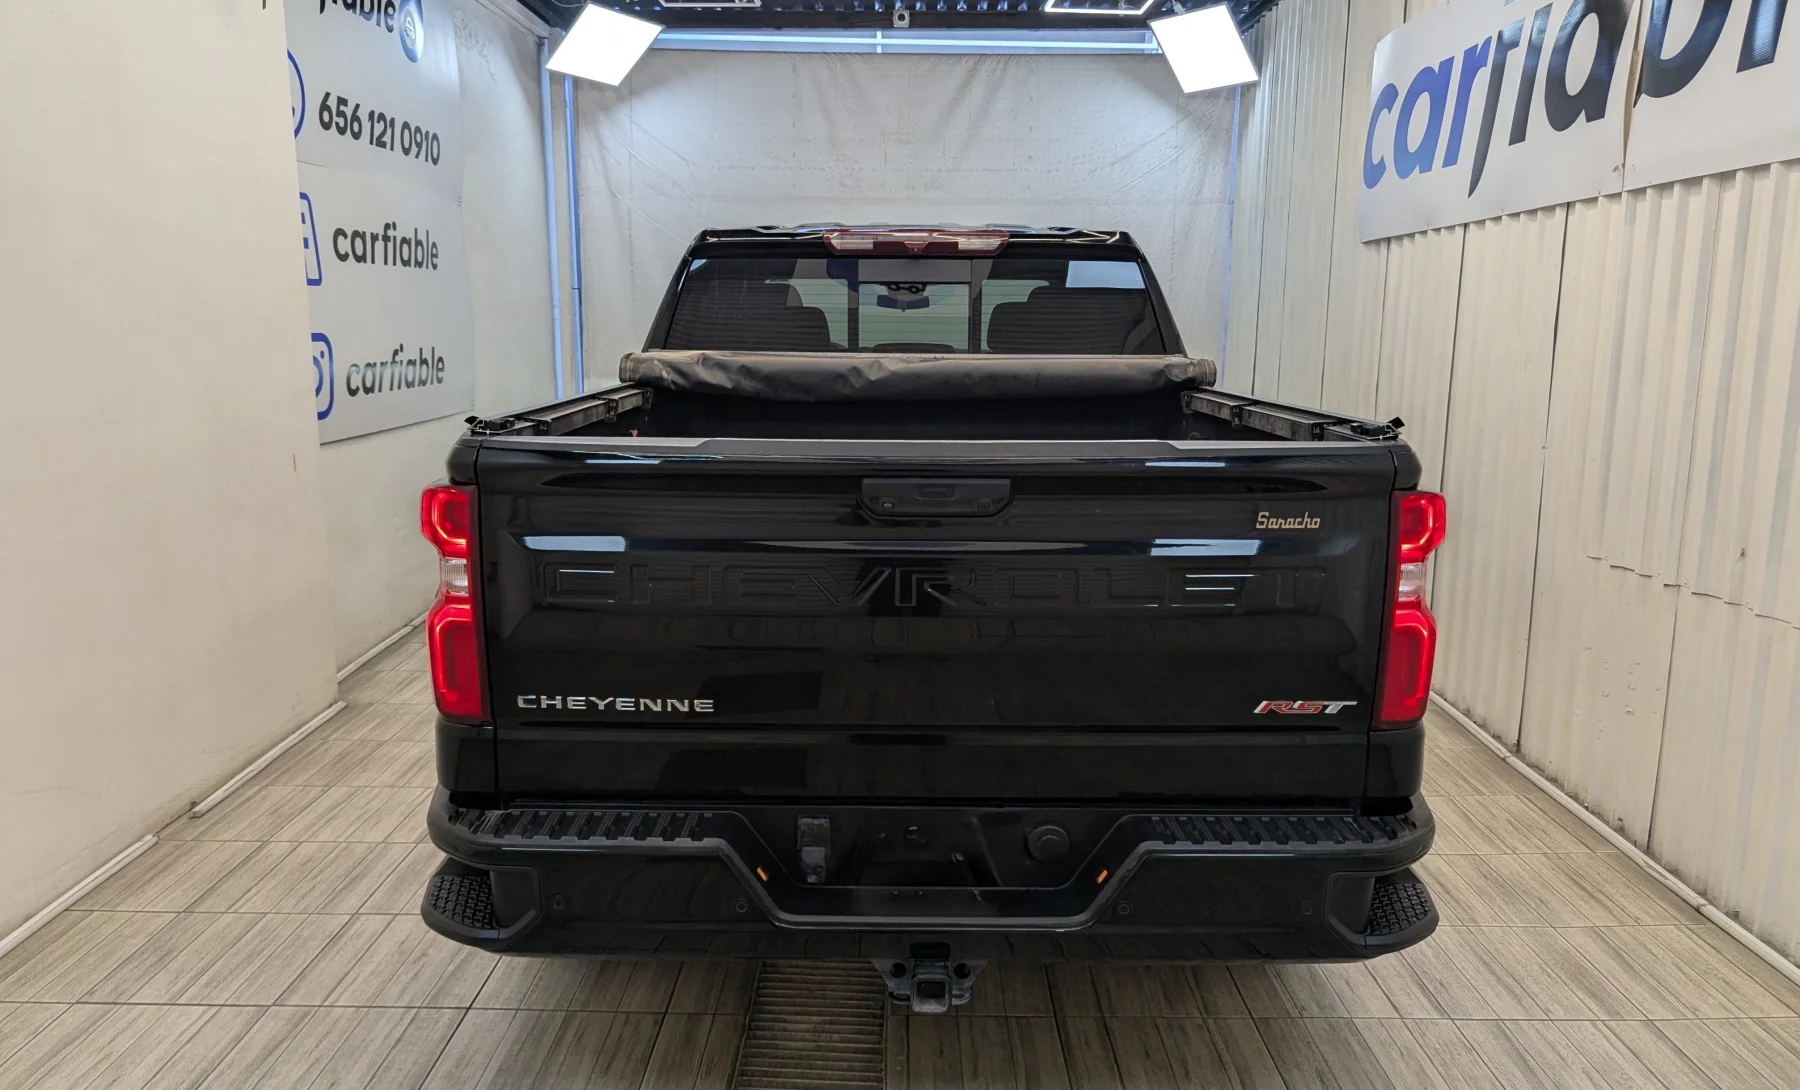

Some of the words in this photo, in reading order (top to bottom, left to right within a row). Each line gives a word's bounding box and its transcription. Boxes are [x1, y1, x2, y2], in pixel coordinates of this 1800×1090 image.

[318, 91, 363, 141] 656
[368, 109, 396, 152] 121
[400, 121, 441, 166] 0910
[332, 221, 439, 271] carfiable
[346, 343, 445, 397] carfiable
[543, 564, 1326, 607] CHEVROLET
[516, 694, 715, 713] CHEYENNE
[1253, 700, 1358, 715] RST
